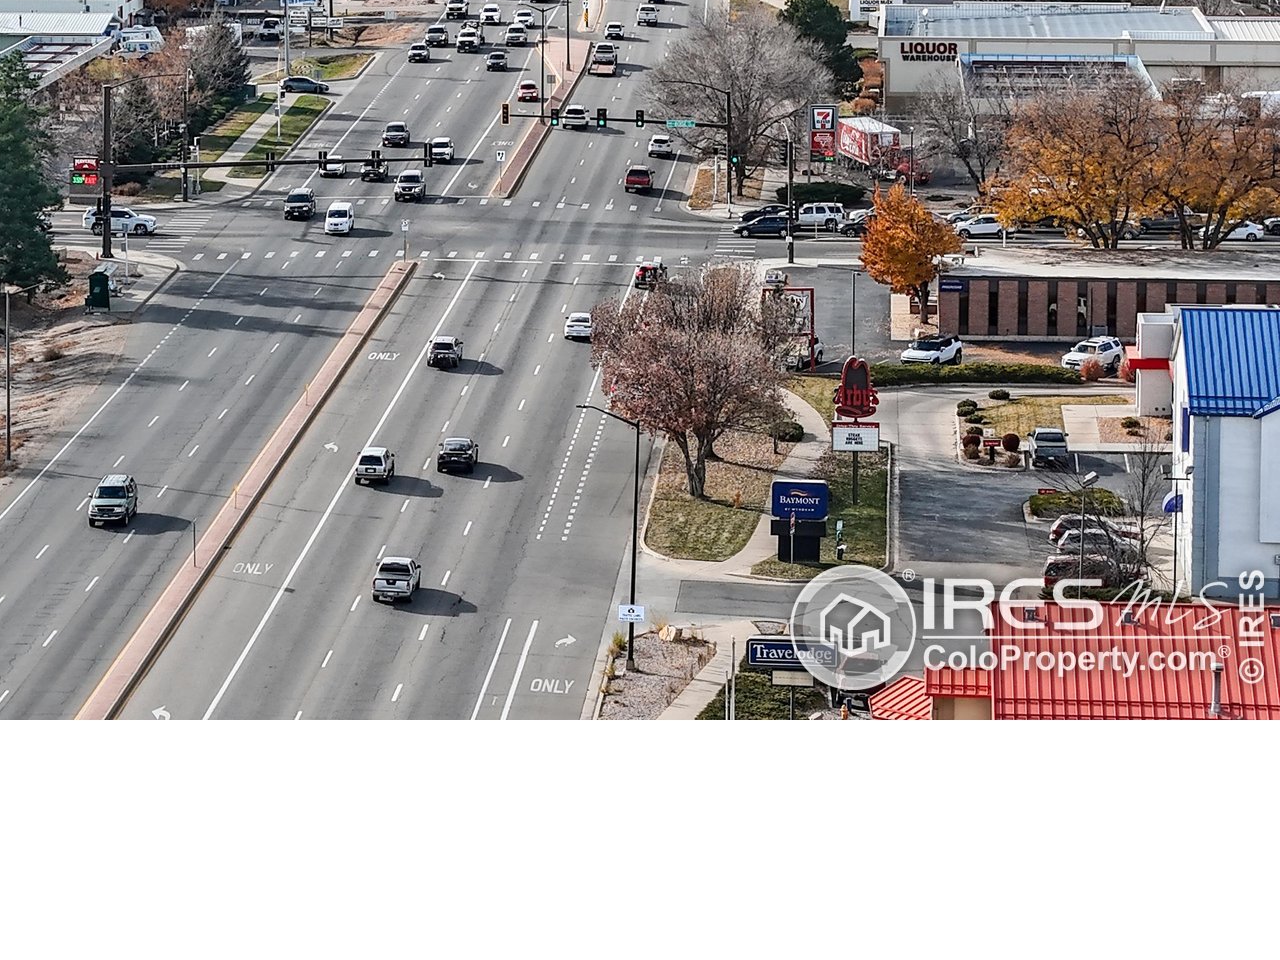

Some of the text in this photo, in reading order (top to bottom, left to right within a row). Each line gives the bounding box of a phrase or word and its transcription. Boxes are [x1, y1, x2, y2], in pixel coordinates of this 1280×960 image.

[900, 42, 958, 54] LIQUOR
[368, 352, 400, 360] ONLY
[779, 495, 821, 505] BAYMONT
[232, 562, 274, 575] ONLY
[752, 644, 832, 663] Travelodge
[530, 678, 575, 694] ONLY
